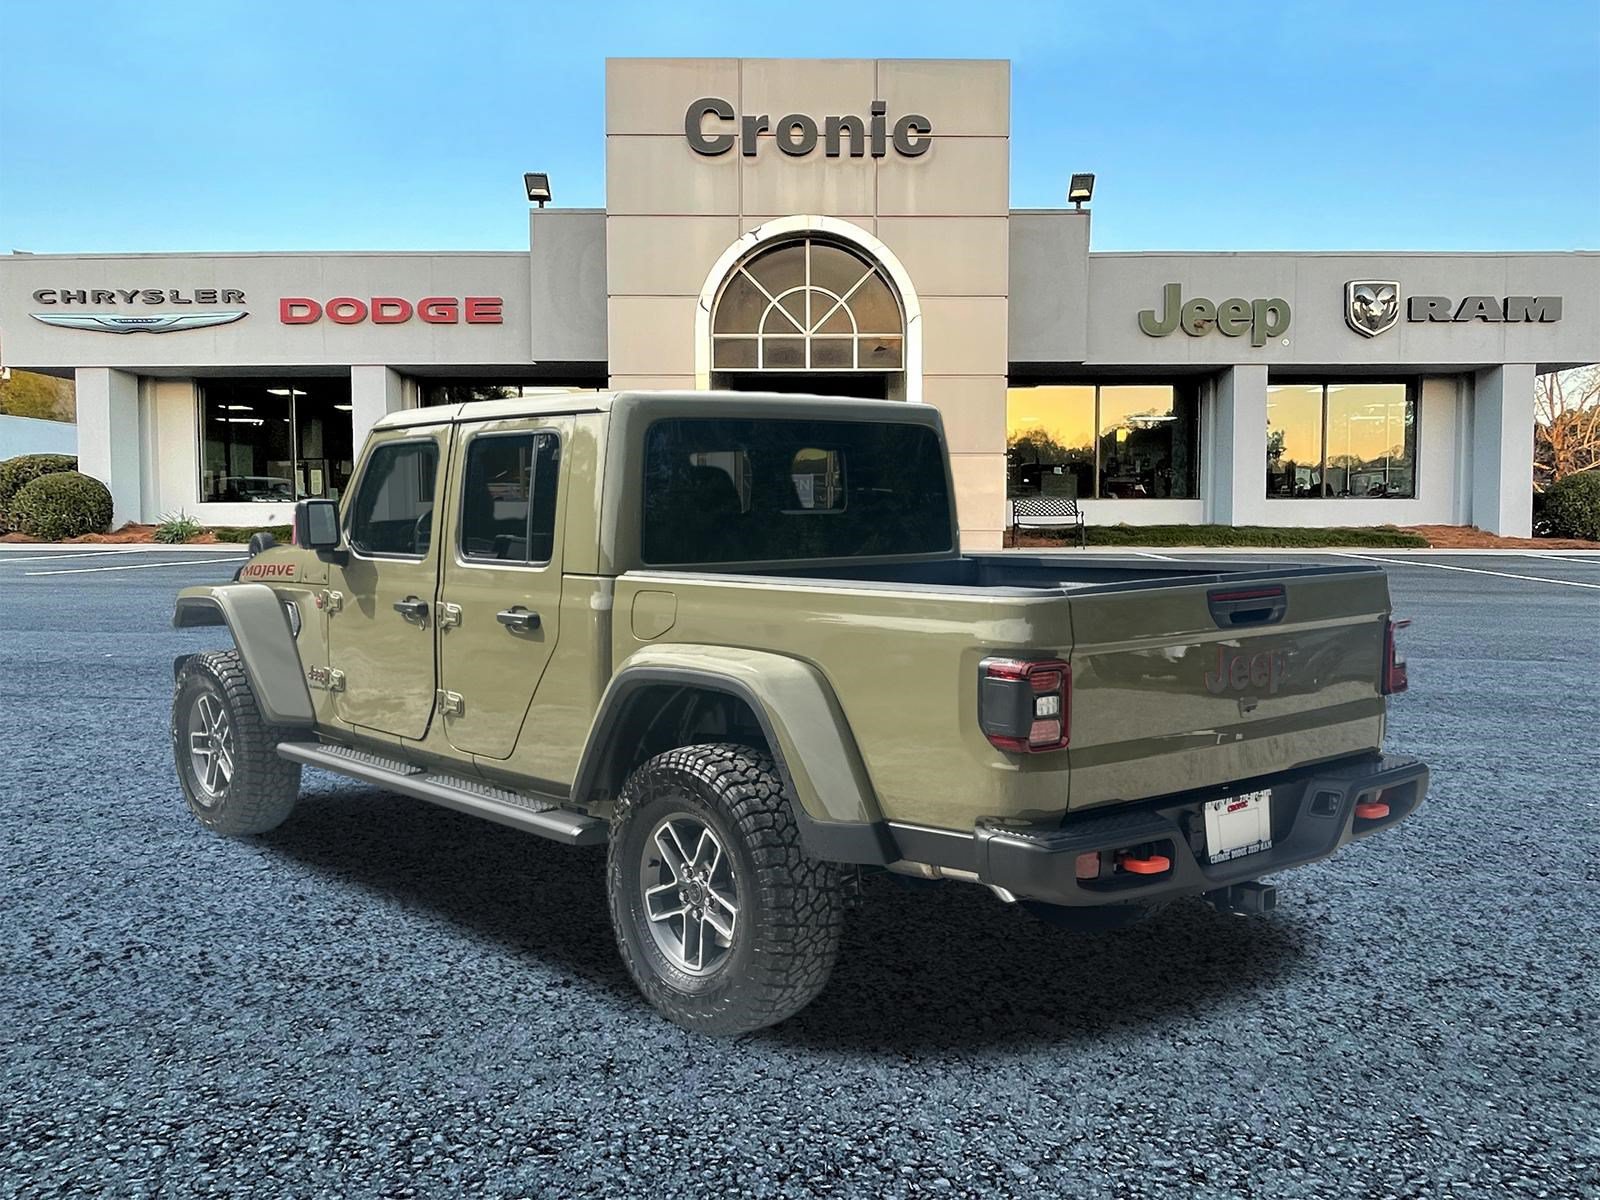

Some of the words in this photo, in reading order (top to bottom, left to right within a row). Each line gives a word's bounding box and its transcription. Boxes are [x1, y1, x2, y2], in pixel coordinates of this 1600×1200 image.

[685, 97, 932, 157] Cronic
[33, 289, 246, 304] CHRYSLER
[1408, 296, 1562, 322] RAM
[280, 297, 503, 324] DODGE
[1138, 283, 1291, 347] Jeep
[242, 564, 296, 577] MOJAVE
[1203, 645, 1287, 694] Jeep
